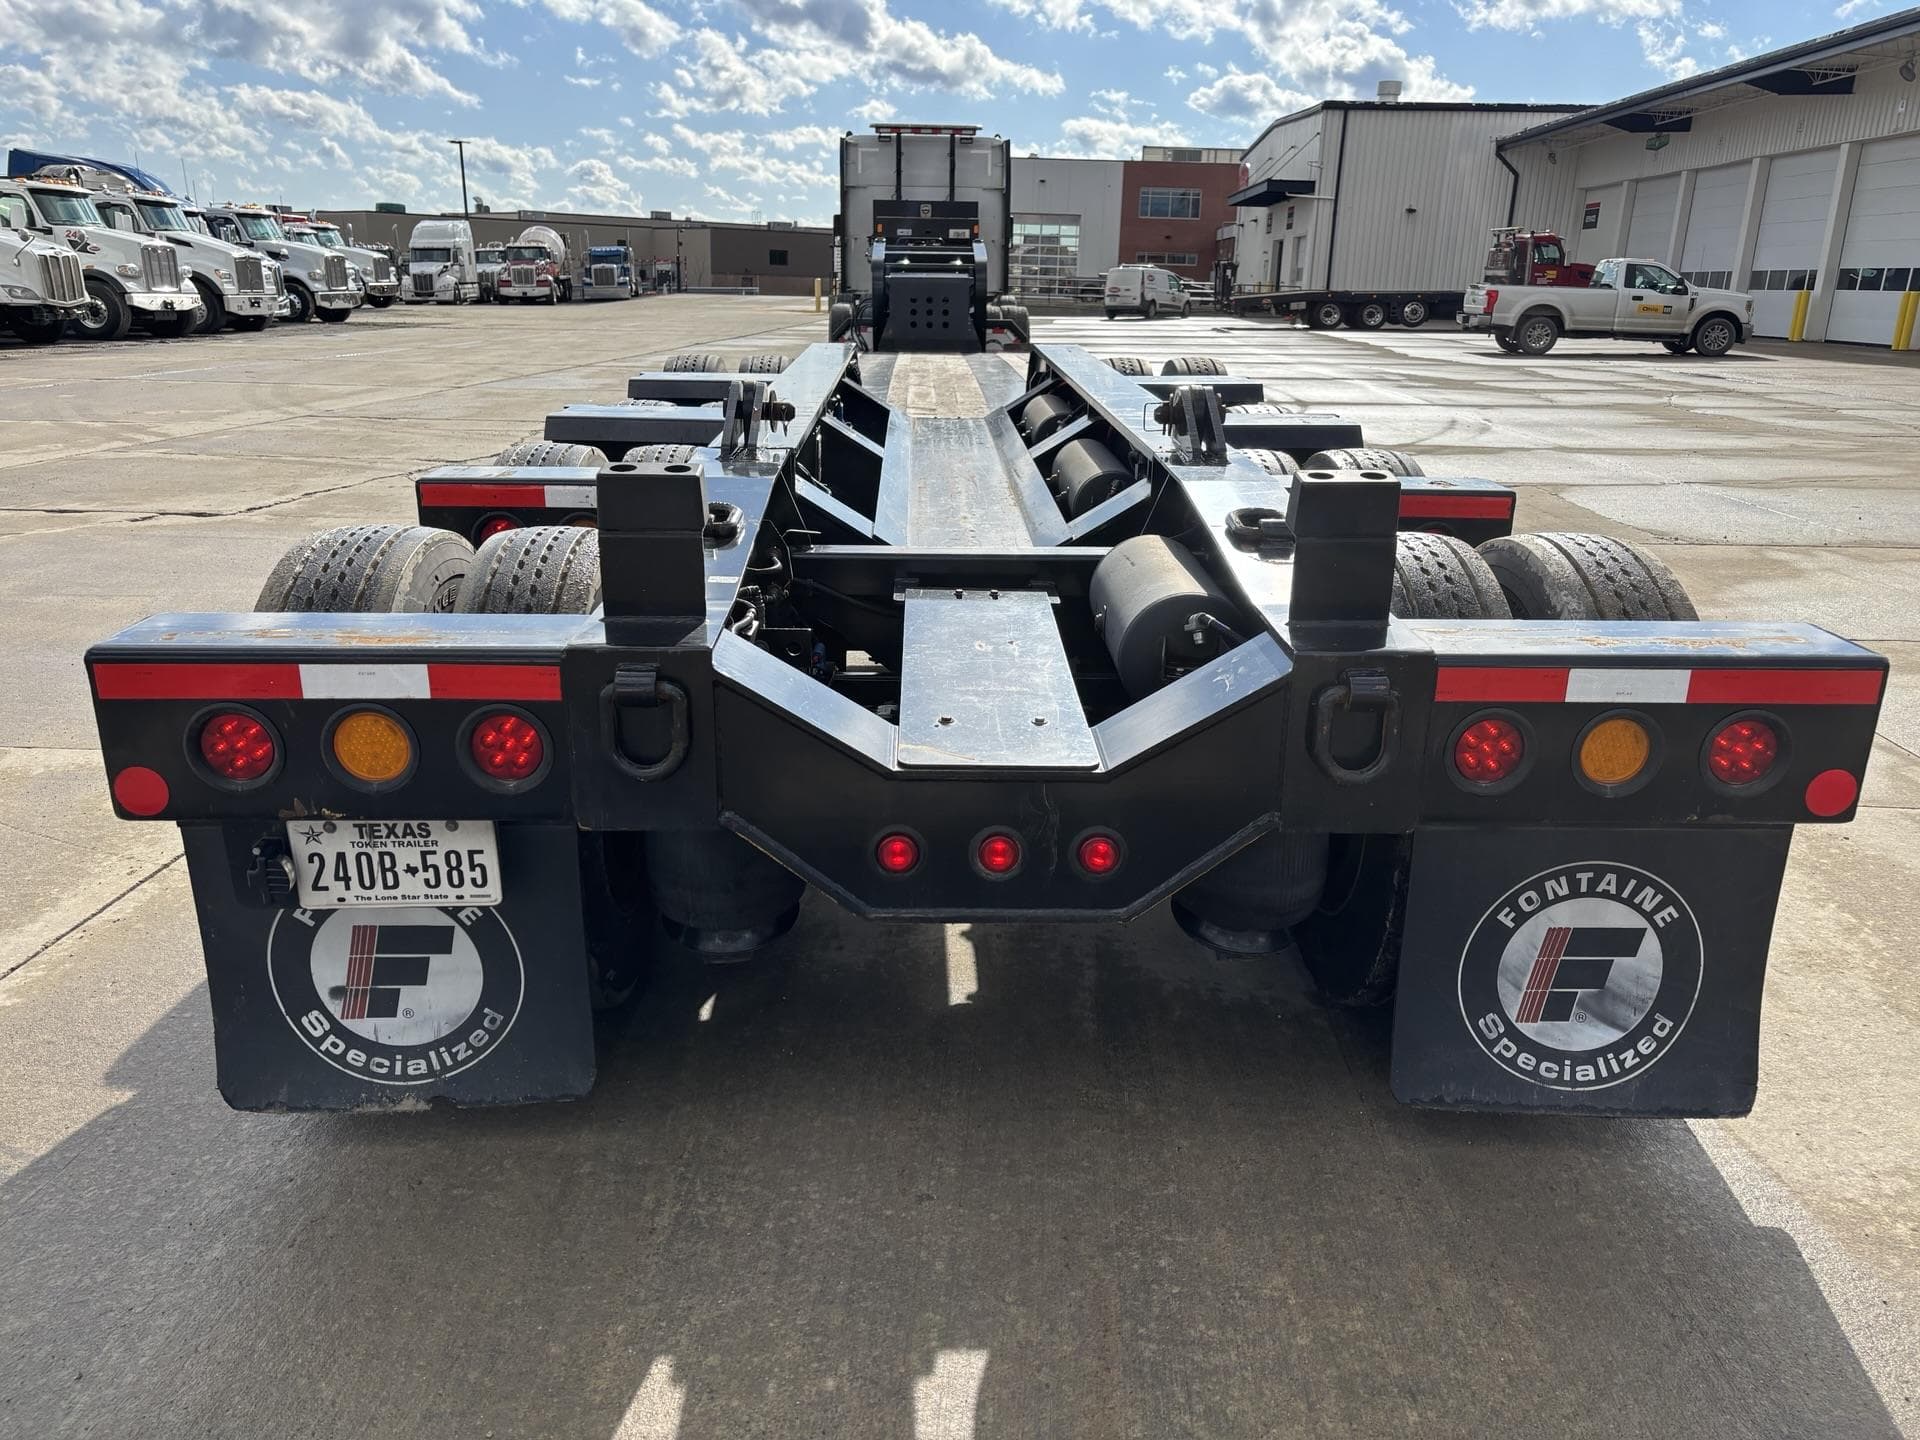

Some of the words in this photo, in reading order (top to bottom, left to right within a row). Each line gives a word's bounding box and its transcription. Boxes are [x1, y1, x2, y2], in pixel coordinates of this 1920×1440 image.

[350, 840, 389, 849] TOKEN
[390, 840, 439, 848] TRAILER
[352, 822, 432, 839] TEXAS
[1497, 872, 1680, 929] FONTAINE
[300, 1007, 504, 1077] Specialized
[1477, 1012, 1674, 1082] Specialized
